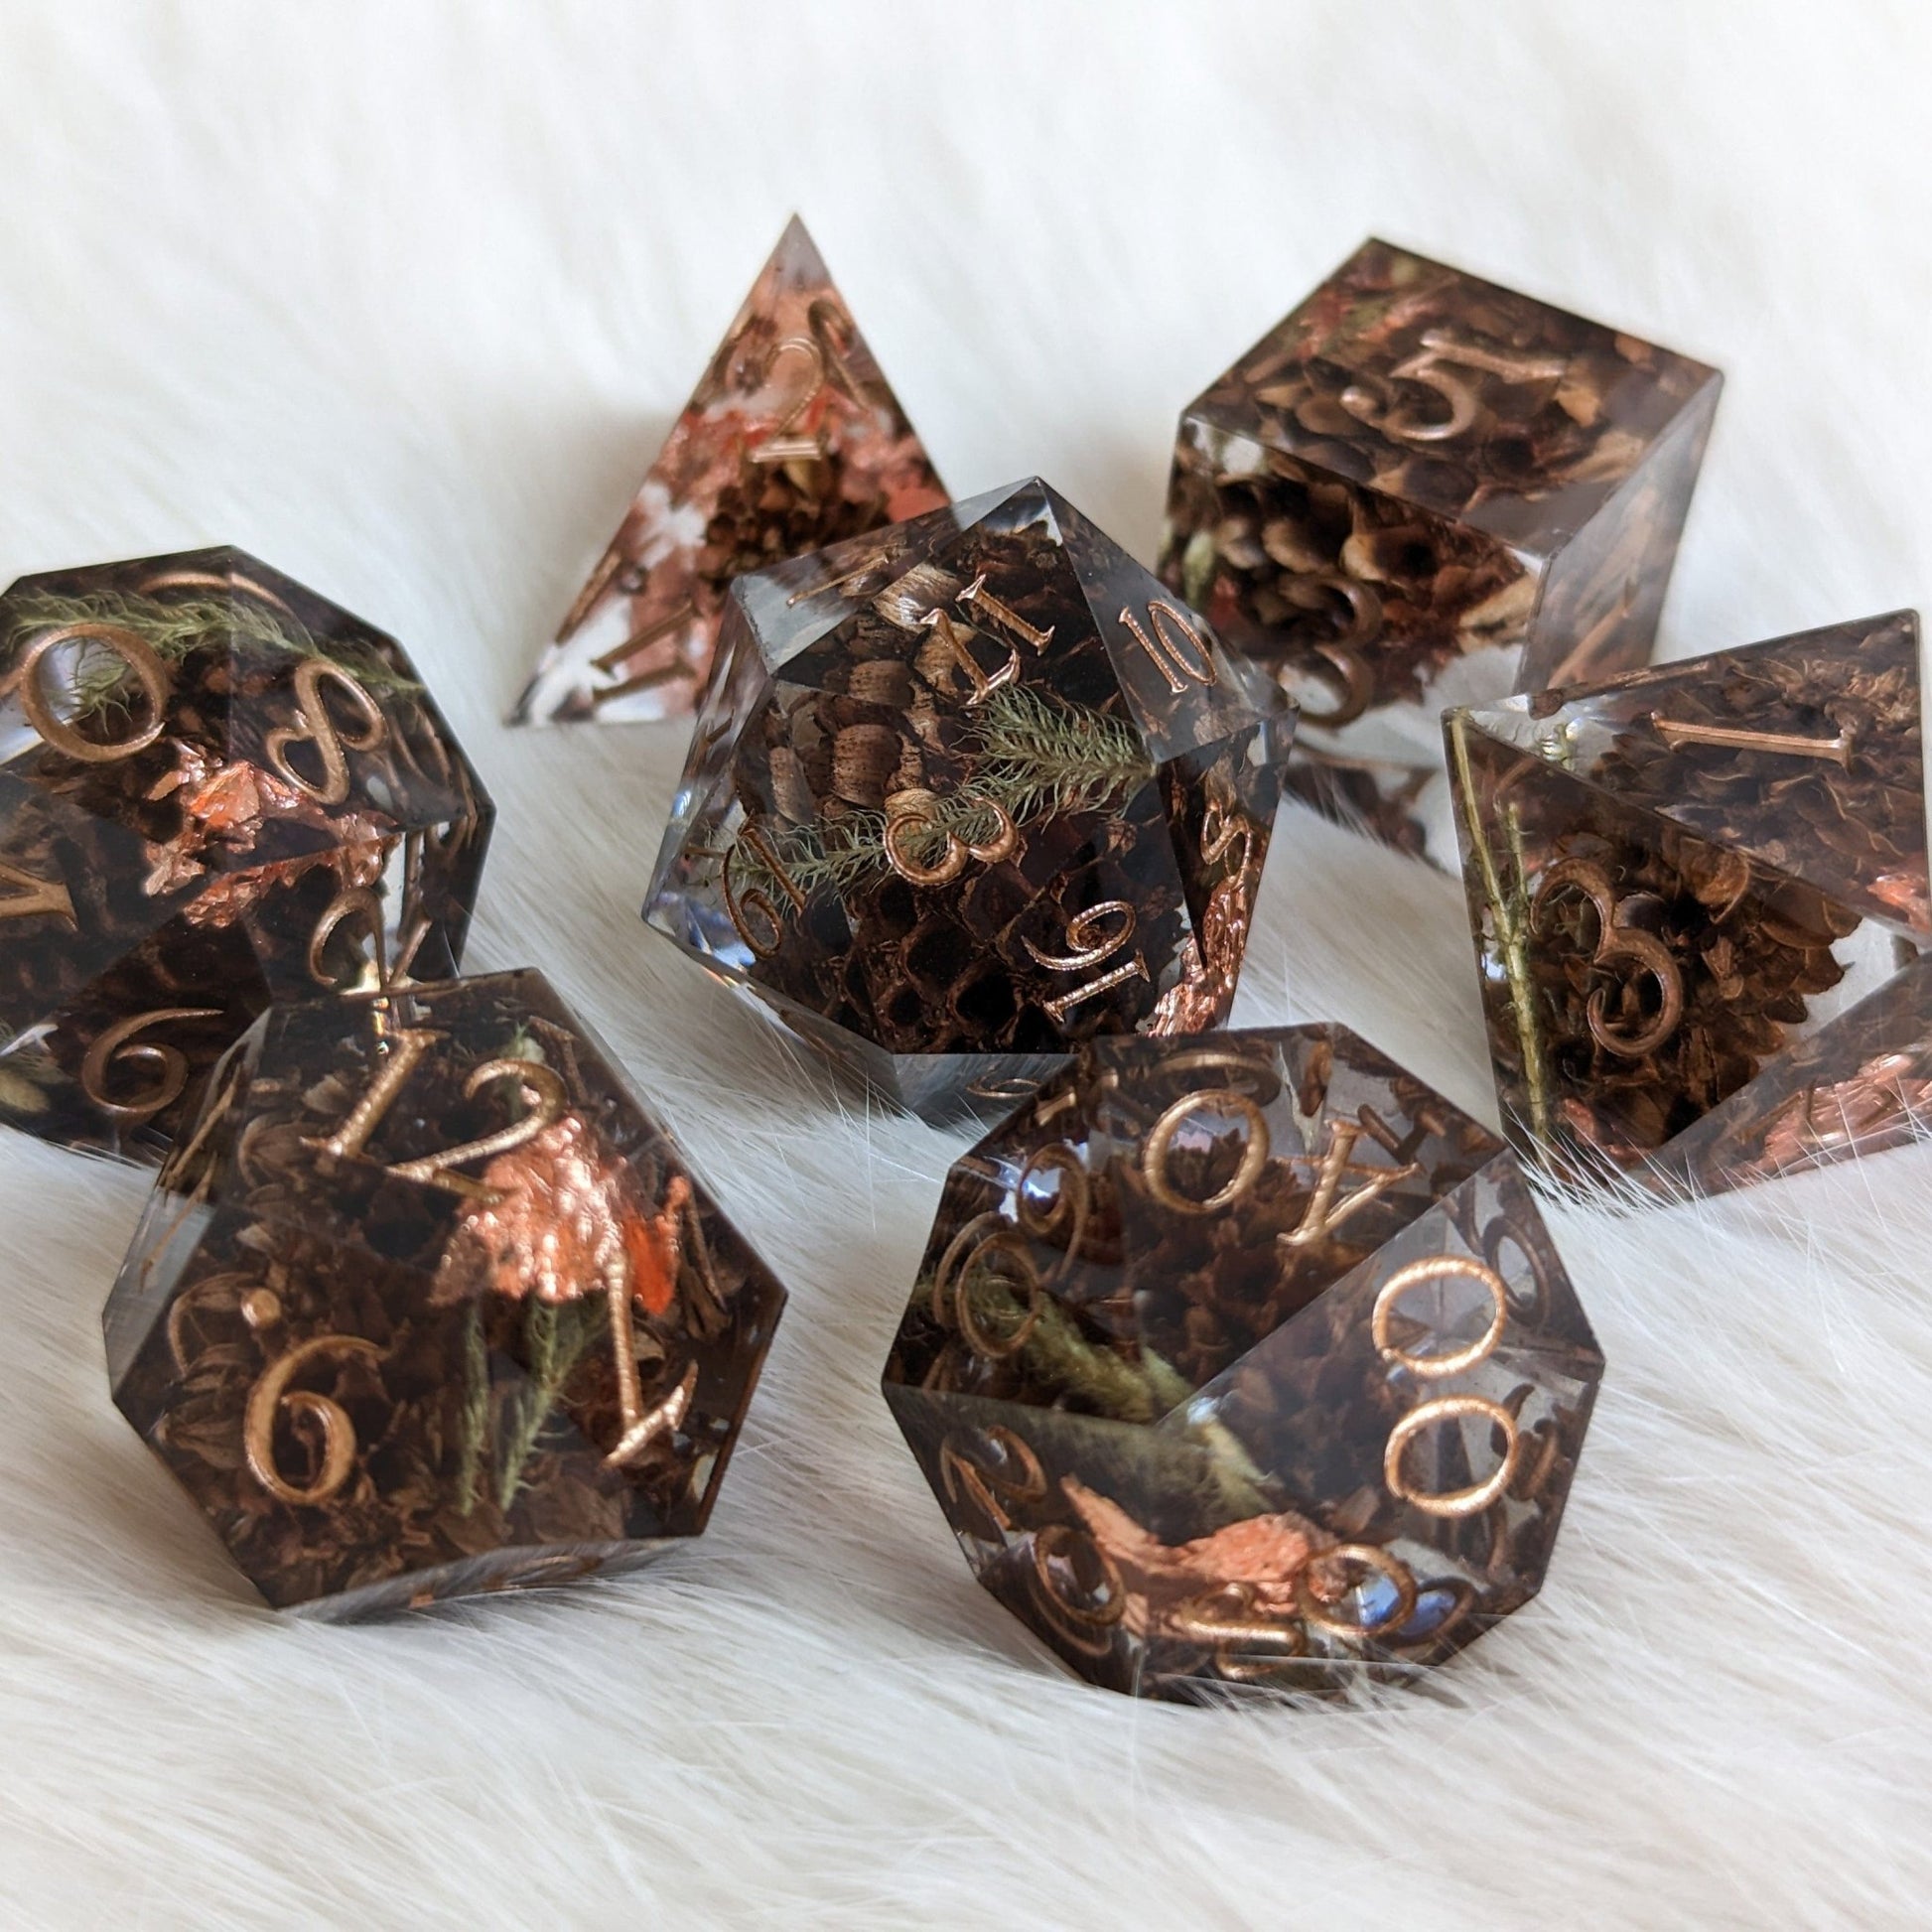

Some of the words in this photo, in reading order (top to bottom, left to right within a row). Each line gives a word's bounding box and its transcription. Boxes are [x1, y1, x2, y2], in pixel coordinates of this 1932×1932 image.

[1341, 328, 1568, 443] 5
[20, 622, 166, 762] 0
[1118, 599, 1217, 694] 10
[266, 658, 388, 805] 8
[1650, 710, 1855, 774] 1
[883, 793, 1021, 887] 3
[1528, 856, 1683, 1057] 3
[80, 1007, 224, 1114] 6
[299, 1028, 567, 1202] 12
